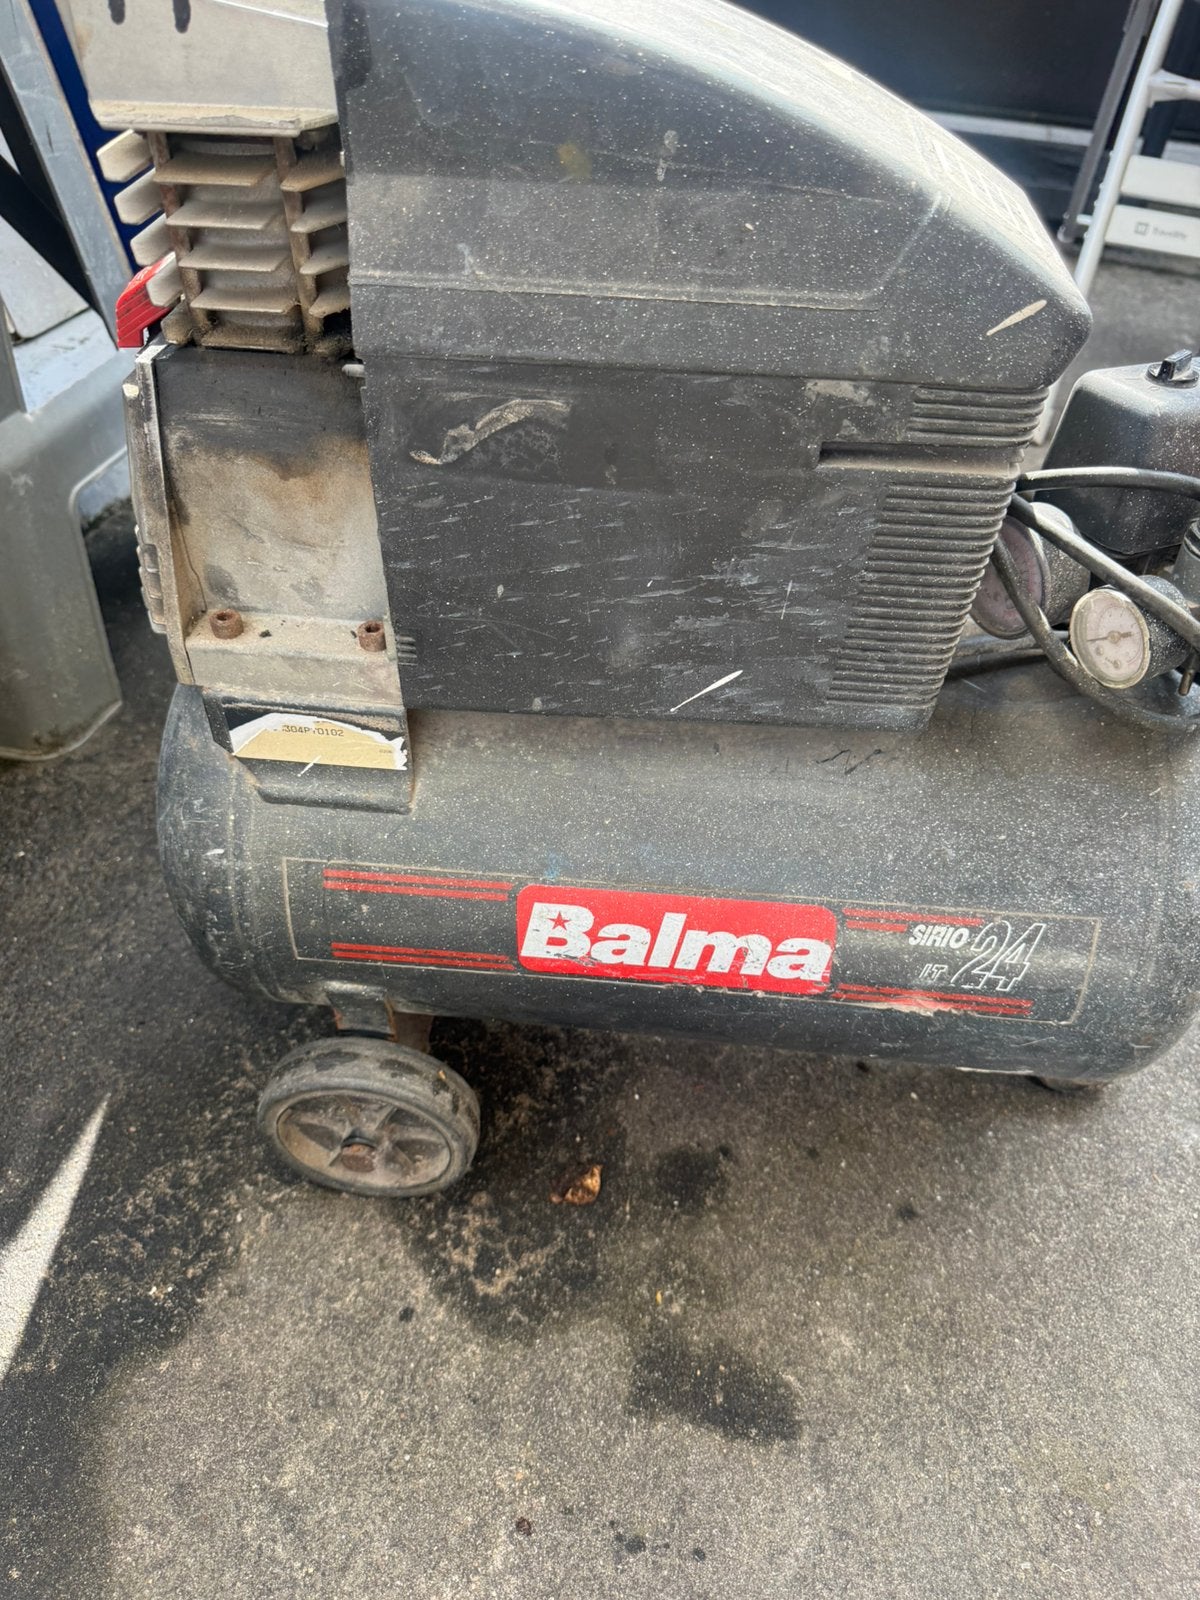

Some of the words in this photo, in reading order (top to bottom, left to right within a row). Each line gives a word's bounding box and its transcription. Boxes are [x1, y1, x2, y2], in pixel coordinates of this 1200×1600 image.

[521, 902, 833, 981] Balma
[909, 924, 970, 949] SIRIO
[950, 920, 1046, 991] 24
